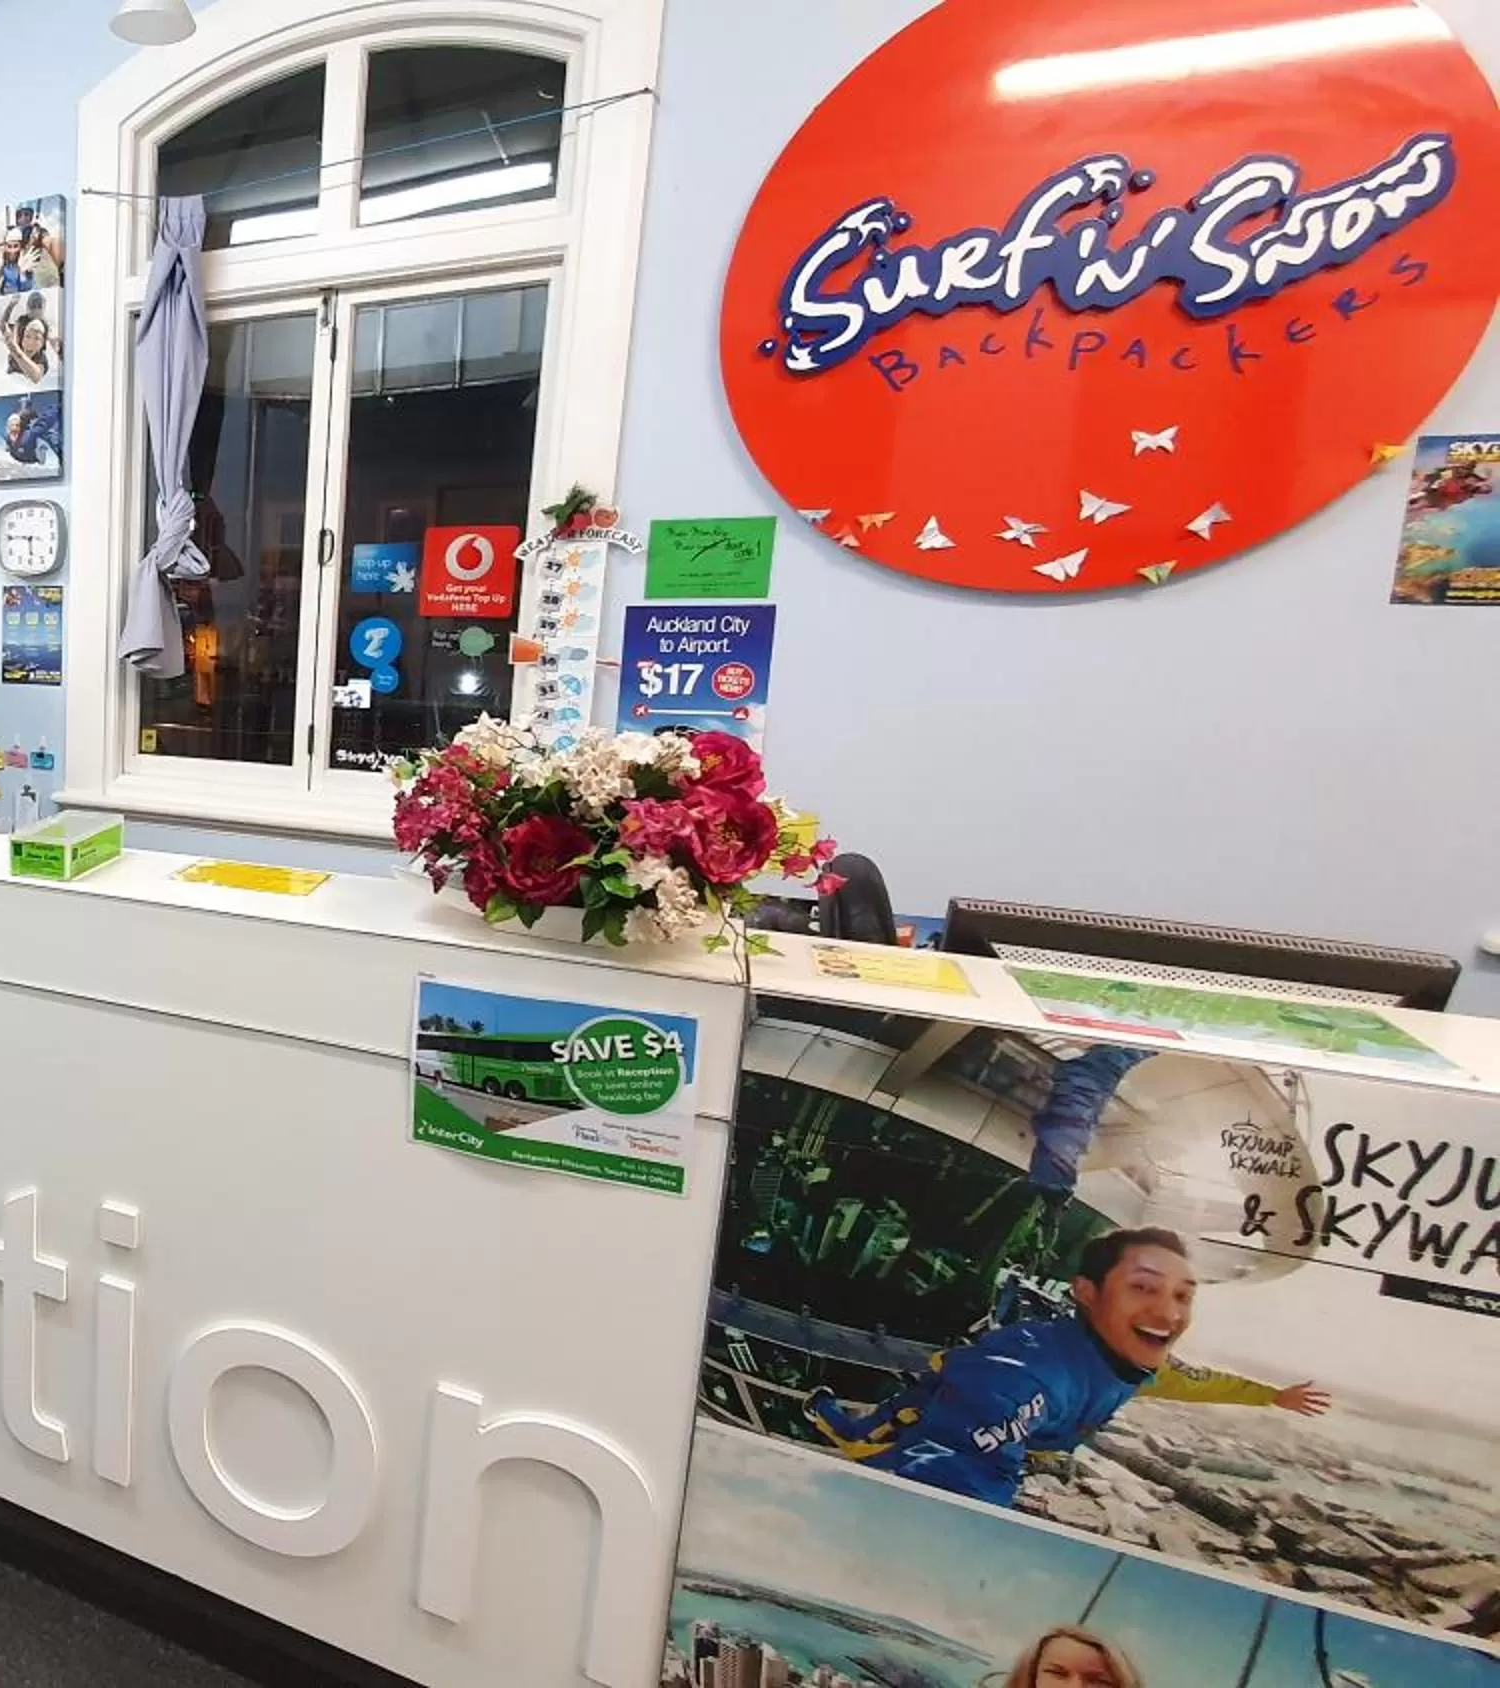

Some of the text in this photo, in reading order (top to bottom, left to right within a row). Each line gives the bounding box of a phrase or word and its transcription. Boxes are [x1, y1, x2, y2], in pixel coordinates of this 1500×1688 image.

[868, 254, 1429, 391] BACKPACKERS
[579, 529, 643, 552] FORECAST
[545, 561, 562, 573] 27
[446, 584, 460, 593] Get
[451, 603, 478, 612] HERE
[647, 615, 751, 636] Auckland City
[659, 637, 732, 656] to Airport.
[638, 662, 705, 698] $17
[551, 1030, 685, 1063] SAVE $4
[617, 1067, 675, 1077] Reception
[1220, 1129, 1297, 1157] SKYJUMP
[1229, 1151, 1301, 1179] SKYWALK
[1240, 1194, 1277, 1236] &
